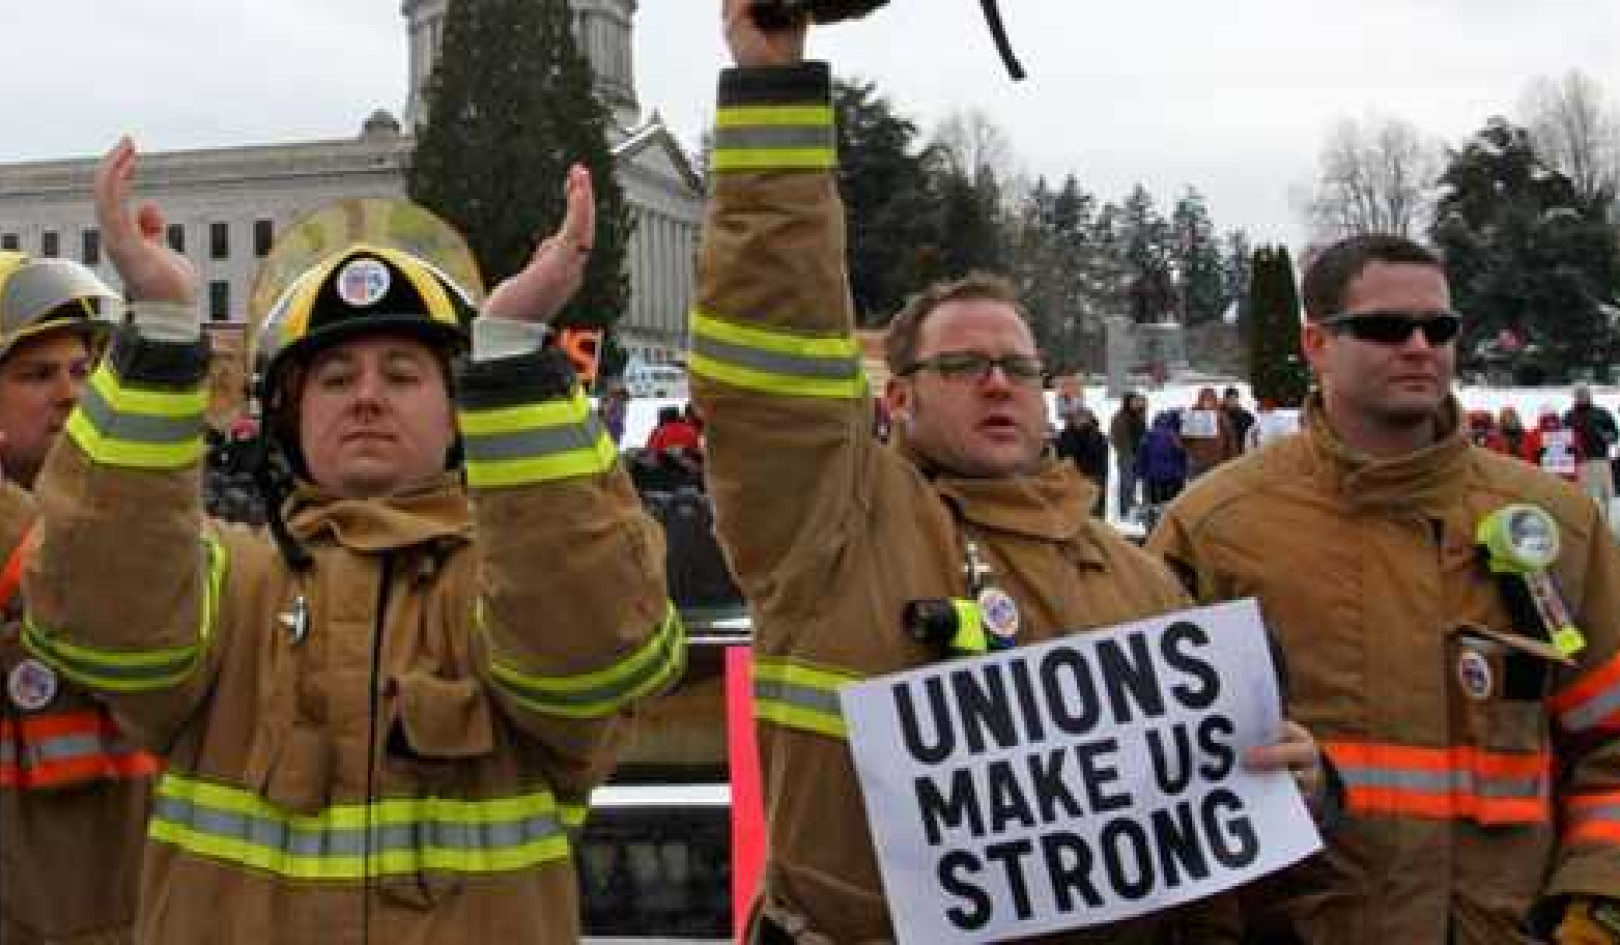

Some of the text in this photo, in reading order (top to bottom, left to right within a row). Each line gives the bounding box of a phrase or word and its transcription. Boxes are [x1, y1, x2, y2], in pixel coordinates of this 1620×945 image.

[892, 621, 1221, 766] UNIONS
[914, 714, 1237, 847] MAKE US
[937, 788, 1260, 932] STRONG
